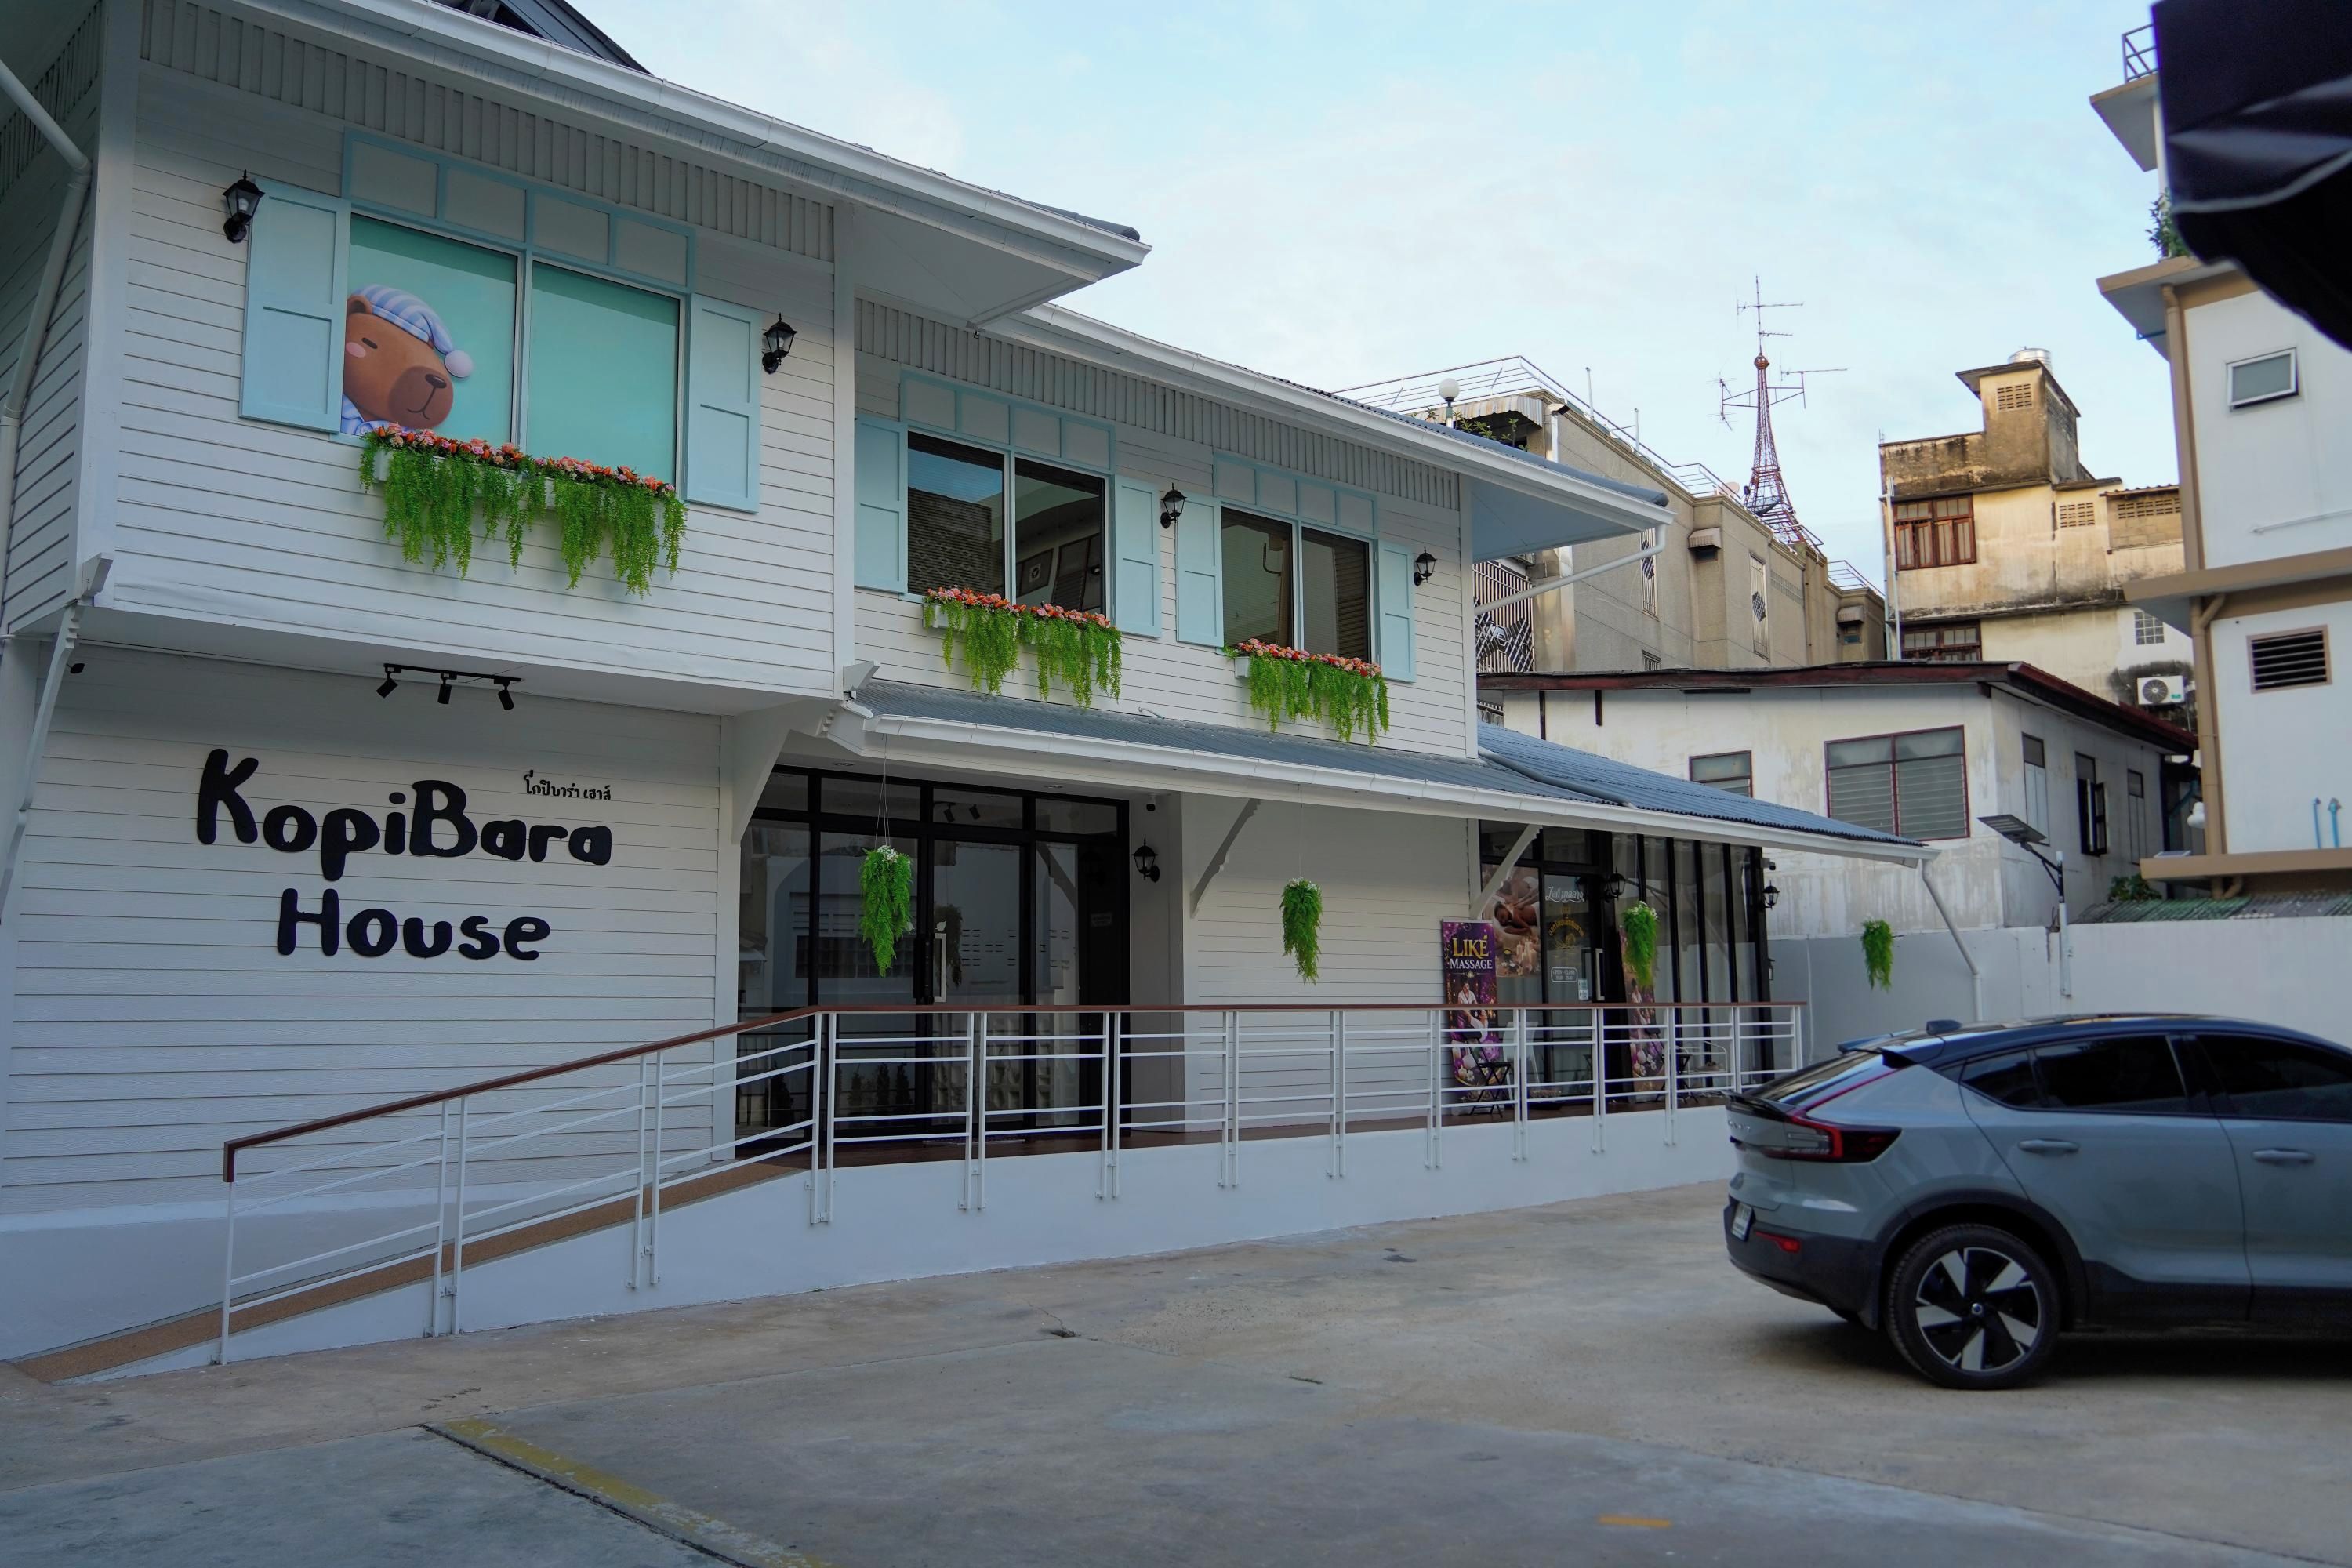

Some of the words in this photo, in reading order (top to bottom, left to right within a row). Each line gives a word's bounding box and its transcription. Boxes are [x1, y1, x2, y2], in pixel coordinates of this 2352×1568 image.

[583, 784, 612, 800] เฮาส์
[196, 748, 612, 882] KopiBara
[276, 887, 550, 961] House
[1452, 937, 1490, 959] LIKE
[1450, 958, 1494, 970] MASSAGE
